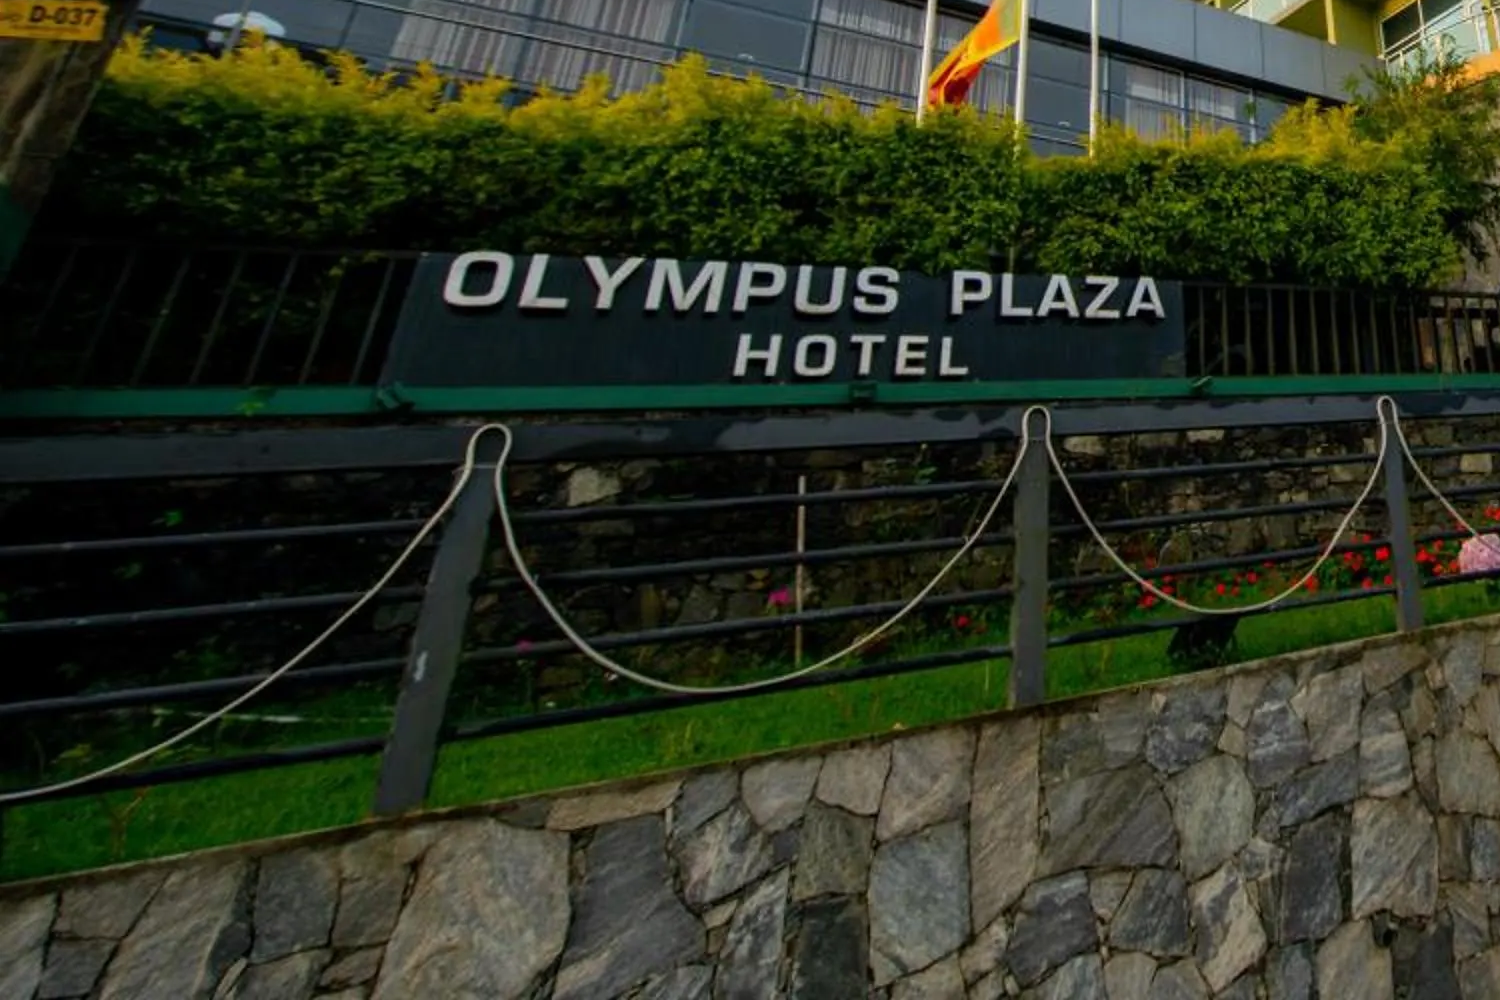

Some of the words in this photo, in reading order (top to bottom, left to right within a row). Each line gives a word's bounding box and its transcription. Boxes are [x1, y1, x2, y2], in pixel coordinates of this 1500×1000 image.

[443, 251, 900, 315] OLYMPUS
[950, 270, 1166, 320] PLAZA
[733, 333, 970, 377] HOTEL
